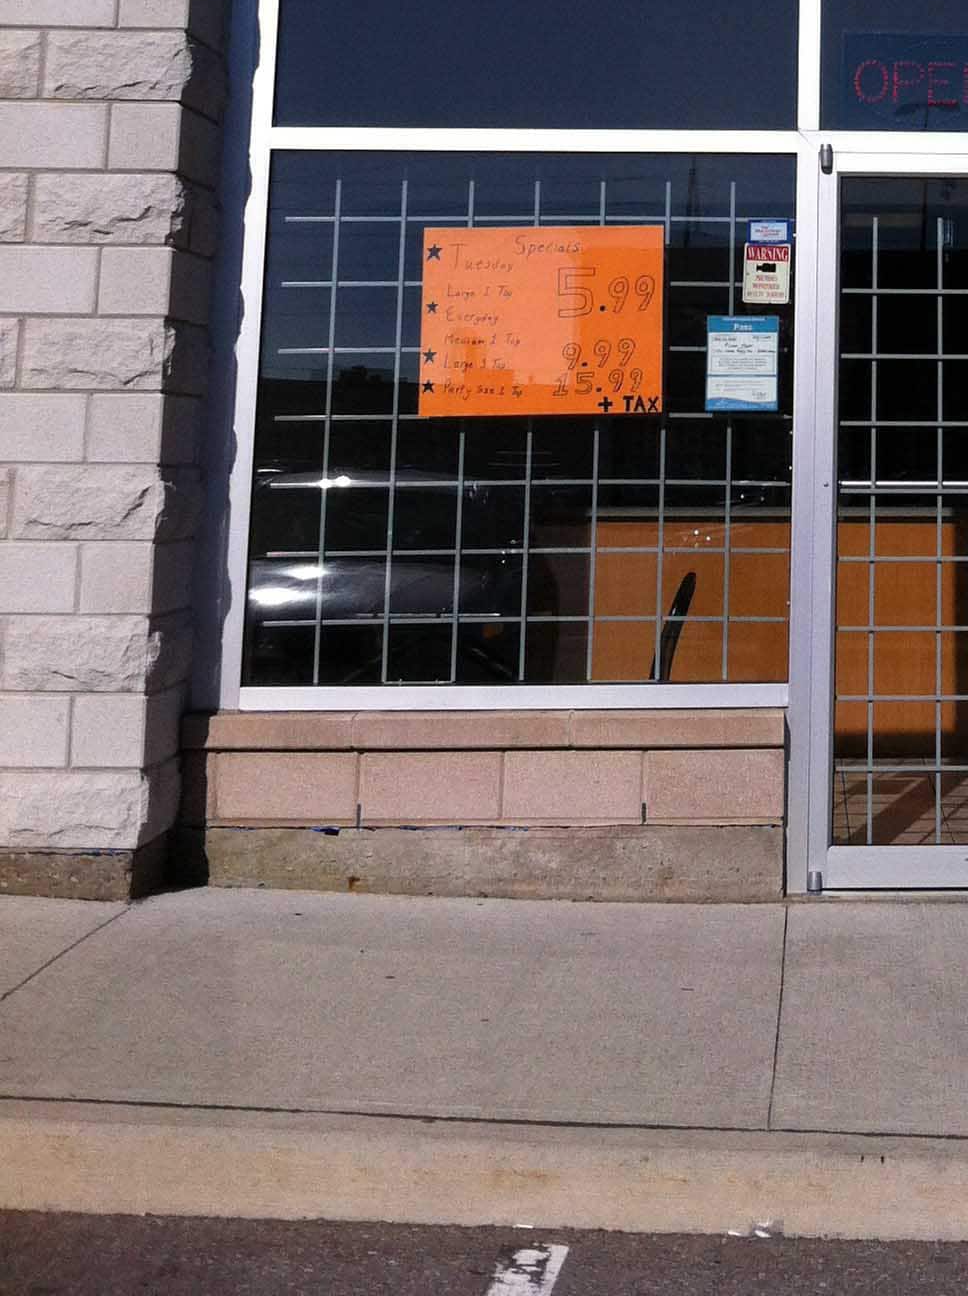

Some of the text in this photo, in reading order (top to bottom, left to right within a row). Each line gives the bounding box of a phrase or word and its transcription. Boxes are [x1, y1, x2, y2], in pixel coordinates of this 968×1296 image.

[448, 242, 513, 273] Tuesday
[514, 234, 582, 258] Specials
[746, 247, 788, 260] WARNING
[447, 283, 475, 300] Large
[557, 266, 656, 319] 5.99
[444, 352, 473, 373] Large
[562, 337, 636, 371] 9.99
[444, 378, 471, 401] Party
[552, 367, 644, 397] 15.99
[622, 394, 660, 412] TAX
